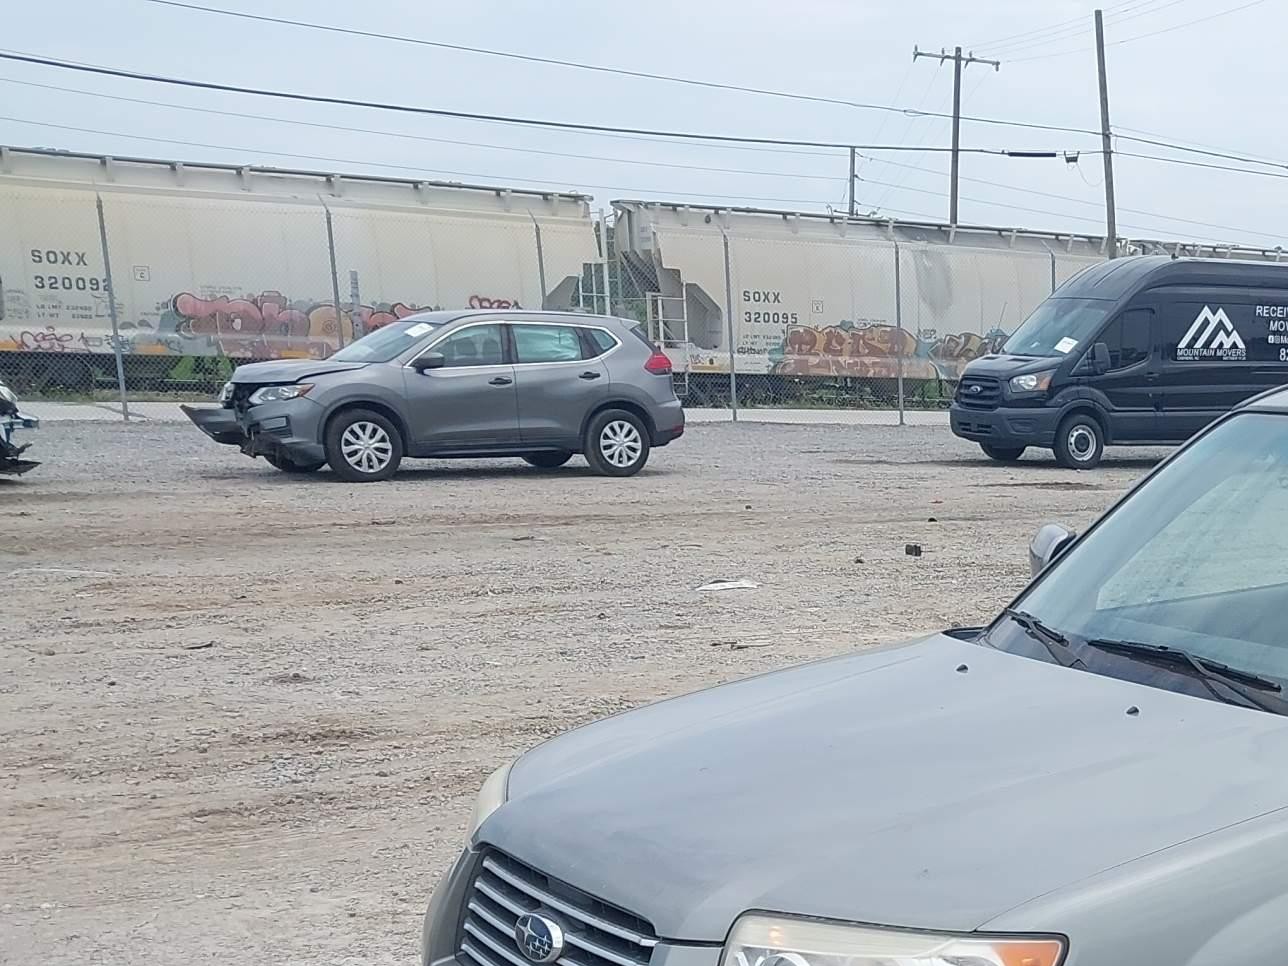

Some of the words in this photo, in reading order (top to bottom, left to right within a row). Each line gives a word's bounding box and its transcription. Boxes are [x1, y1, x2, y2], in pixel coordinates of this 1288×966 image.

[31, 249, 87, 266] SOXX
[743, 290, 781, 304] SOXX
[744, 311, 798, 324] 320095
[1177, 348, 1215, 357] MOUNTAIN
[1216, 349, 1247, 357] MOVERS
